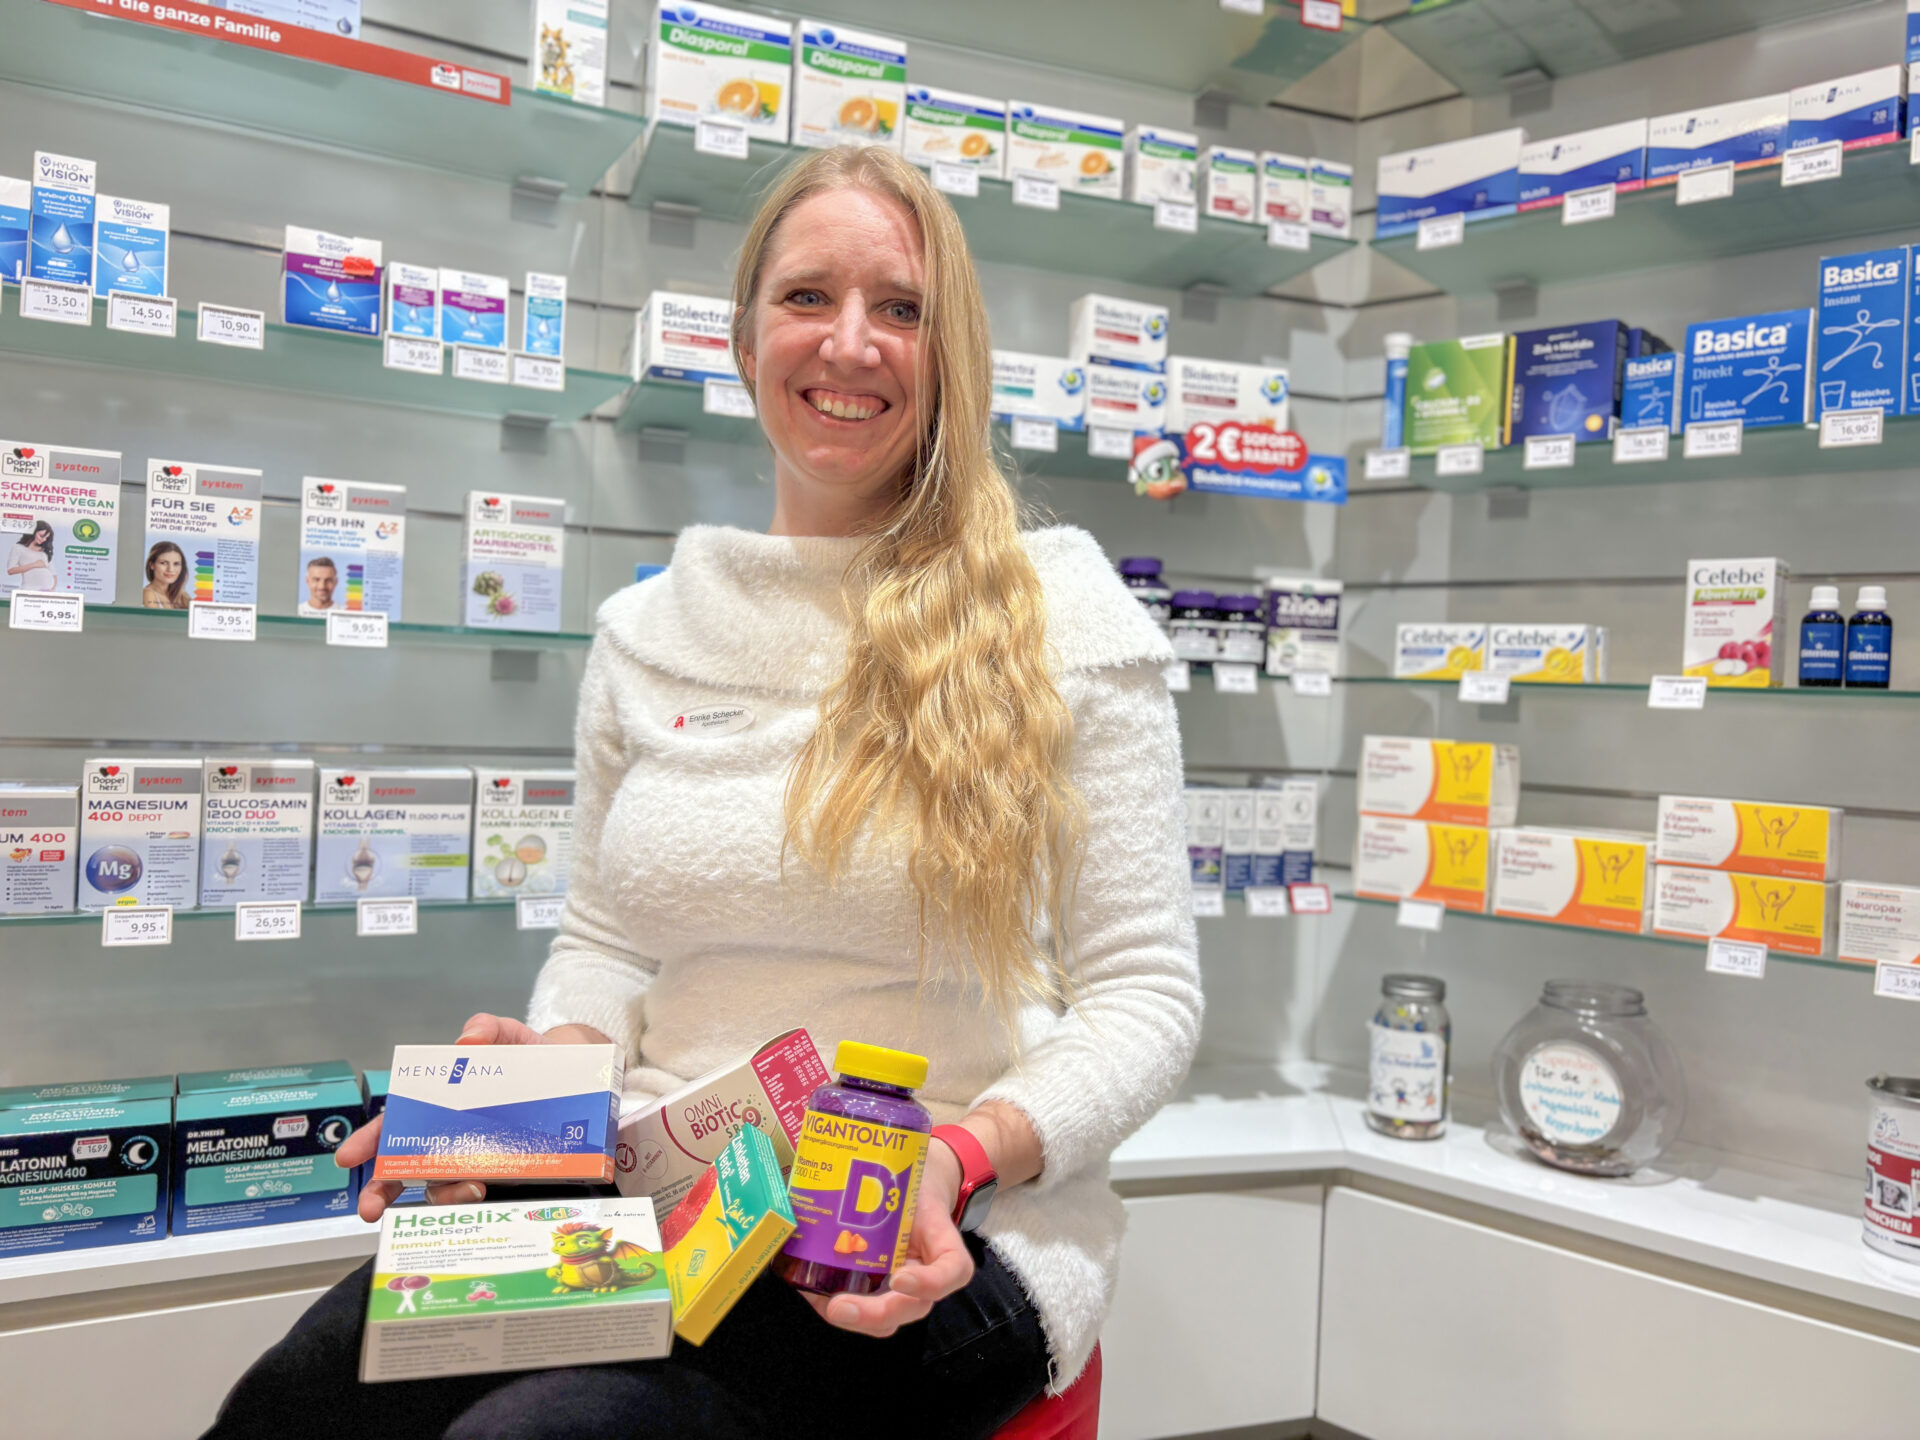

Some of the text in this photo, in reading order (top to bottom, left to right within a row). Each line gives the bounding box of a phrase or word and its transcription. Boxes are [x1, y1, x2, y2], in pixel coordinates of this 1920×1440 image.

[153, 4, 211, 27] ganze
[214, 17, 281, 42] Familie
[669, 28, 750, 56] Diasporal
[811, 52, 885, 78] Diasporal
[1873, 110, 1887, 122] 28
[1761, 142, 1775, 153] 30
[52, 160, 83, 172] HYLO-
[45, 294, 77, 308] 13,50
[1824, 294, 1861, 308] Instant
[131, 306, 162, 320] 14,50
[662, 302, 731, 323] Biolectra
[1096, 304, 1142, 323] Biolectra
[220, 319, 250, 333] 10,90
[1183, 366, 1238, 383] Biolectra
[1693, 365, 1733, 381] Direkt
[1092, 373, 1139, 390] Biolectra
[1851, 388, 1890, 399] Basisches
[1851, 396, 1894, 408] Trinkpulver
[1841, 425, 1869, 436] 16,90
[7, 457, 100, 475] Doppel system
[156, 474, 243, 491] Doppel system
[1, 481, 97, 498] SCHWANGERE
[11, 491, 114, 509] MÜTTER VEGAN
[151, 497, 215, 513] FÜR SIE
[352, 496, 389, 508] system
[77, 507, 114, 517] STILLZEIT
[151, 510, 188, 519] VITAMINE
[231, 506, 253, 516] A-Z
[150, 517, 217, 528] MINERALSTOFFE
[306, 514, 365, 529] FÜR IHN
[151, 523, 168, 531] FÜR
[184, 525, 206, 533] FRAU
[473, 538, 557, 553] MARIENDISTEL
[40, 610, 72, 621] 16,95
[1694, 609, 1727, 619] Vitamin
[217, 616, 242, 627] 9,95
[352, 622, 375, 634] 9,95
[93, 776, 183, 788] Doppel system
[212, 776, 296, 787] Doppel system
[374, 787, 416, 797] system
[88, 800, 188, 810] MAGNESIUM
[207, 799, 308, 809] GLUCOSAMIN
[88, 812, 163, 822] 400 DEPOT
[207, 810, 276, 820] 1200 DUO
[324, 810, 406, 820] KOLLAGEN
[481, 809, 559, 820] KOLLAGEN
[1664, 813, 1699, 824] Vitamin
[30, 832, 66, 844] 400
[99, 861, 132, 880] Mg
[1661, 883, 1696, 895] Vitamin
[131, 922, 156, 934] 9,95
[255, 917, 287, 929] 26,95
[398, 1064, 503, 1078] MENSSANA
[745, 1109, 757, 1125] 9
[564, 1126, 584, 1139] 30
[806, 1114, 909, 1151] VIGANTOLVIT
[187, 1135, 269, 1154] MELATONIN
[387, 1132, 486, 1147] Immuno akut
[0, 1155, 67, 1173] LATONIN
[731, 1131, 751, 1188] Zinkletten
[821, 1161, 833, 1172] D3
[808, 1170, 821, 1182] I.E.
[527, 1207, 581, 1221] Kids
[448, 1237, 510, 1246] Lutscher
[761, 1227, 788, 1264] Zinkletten
[422, 1291, 433, 1300] 6
